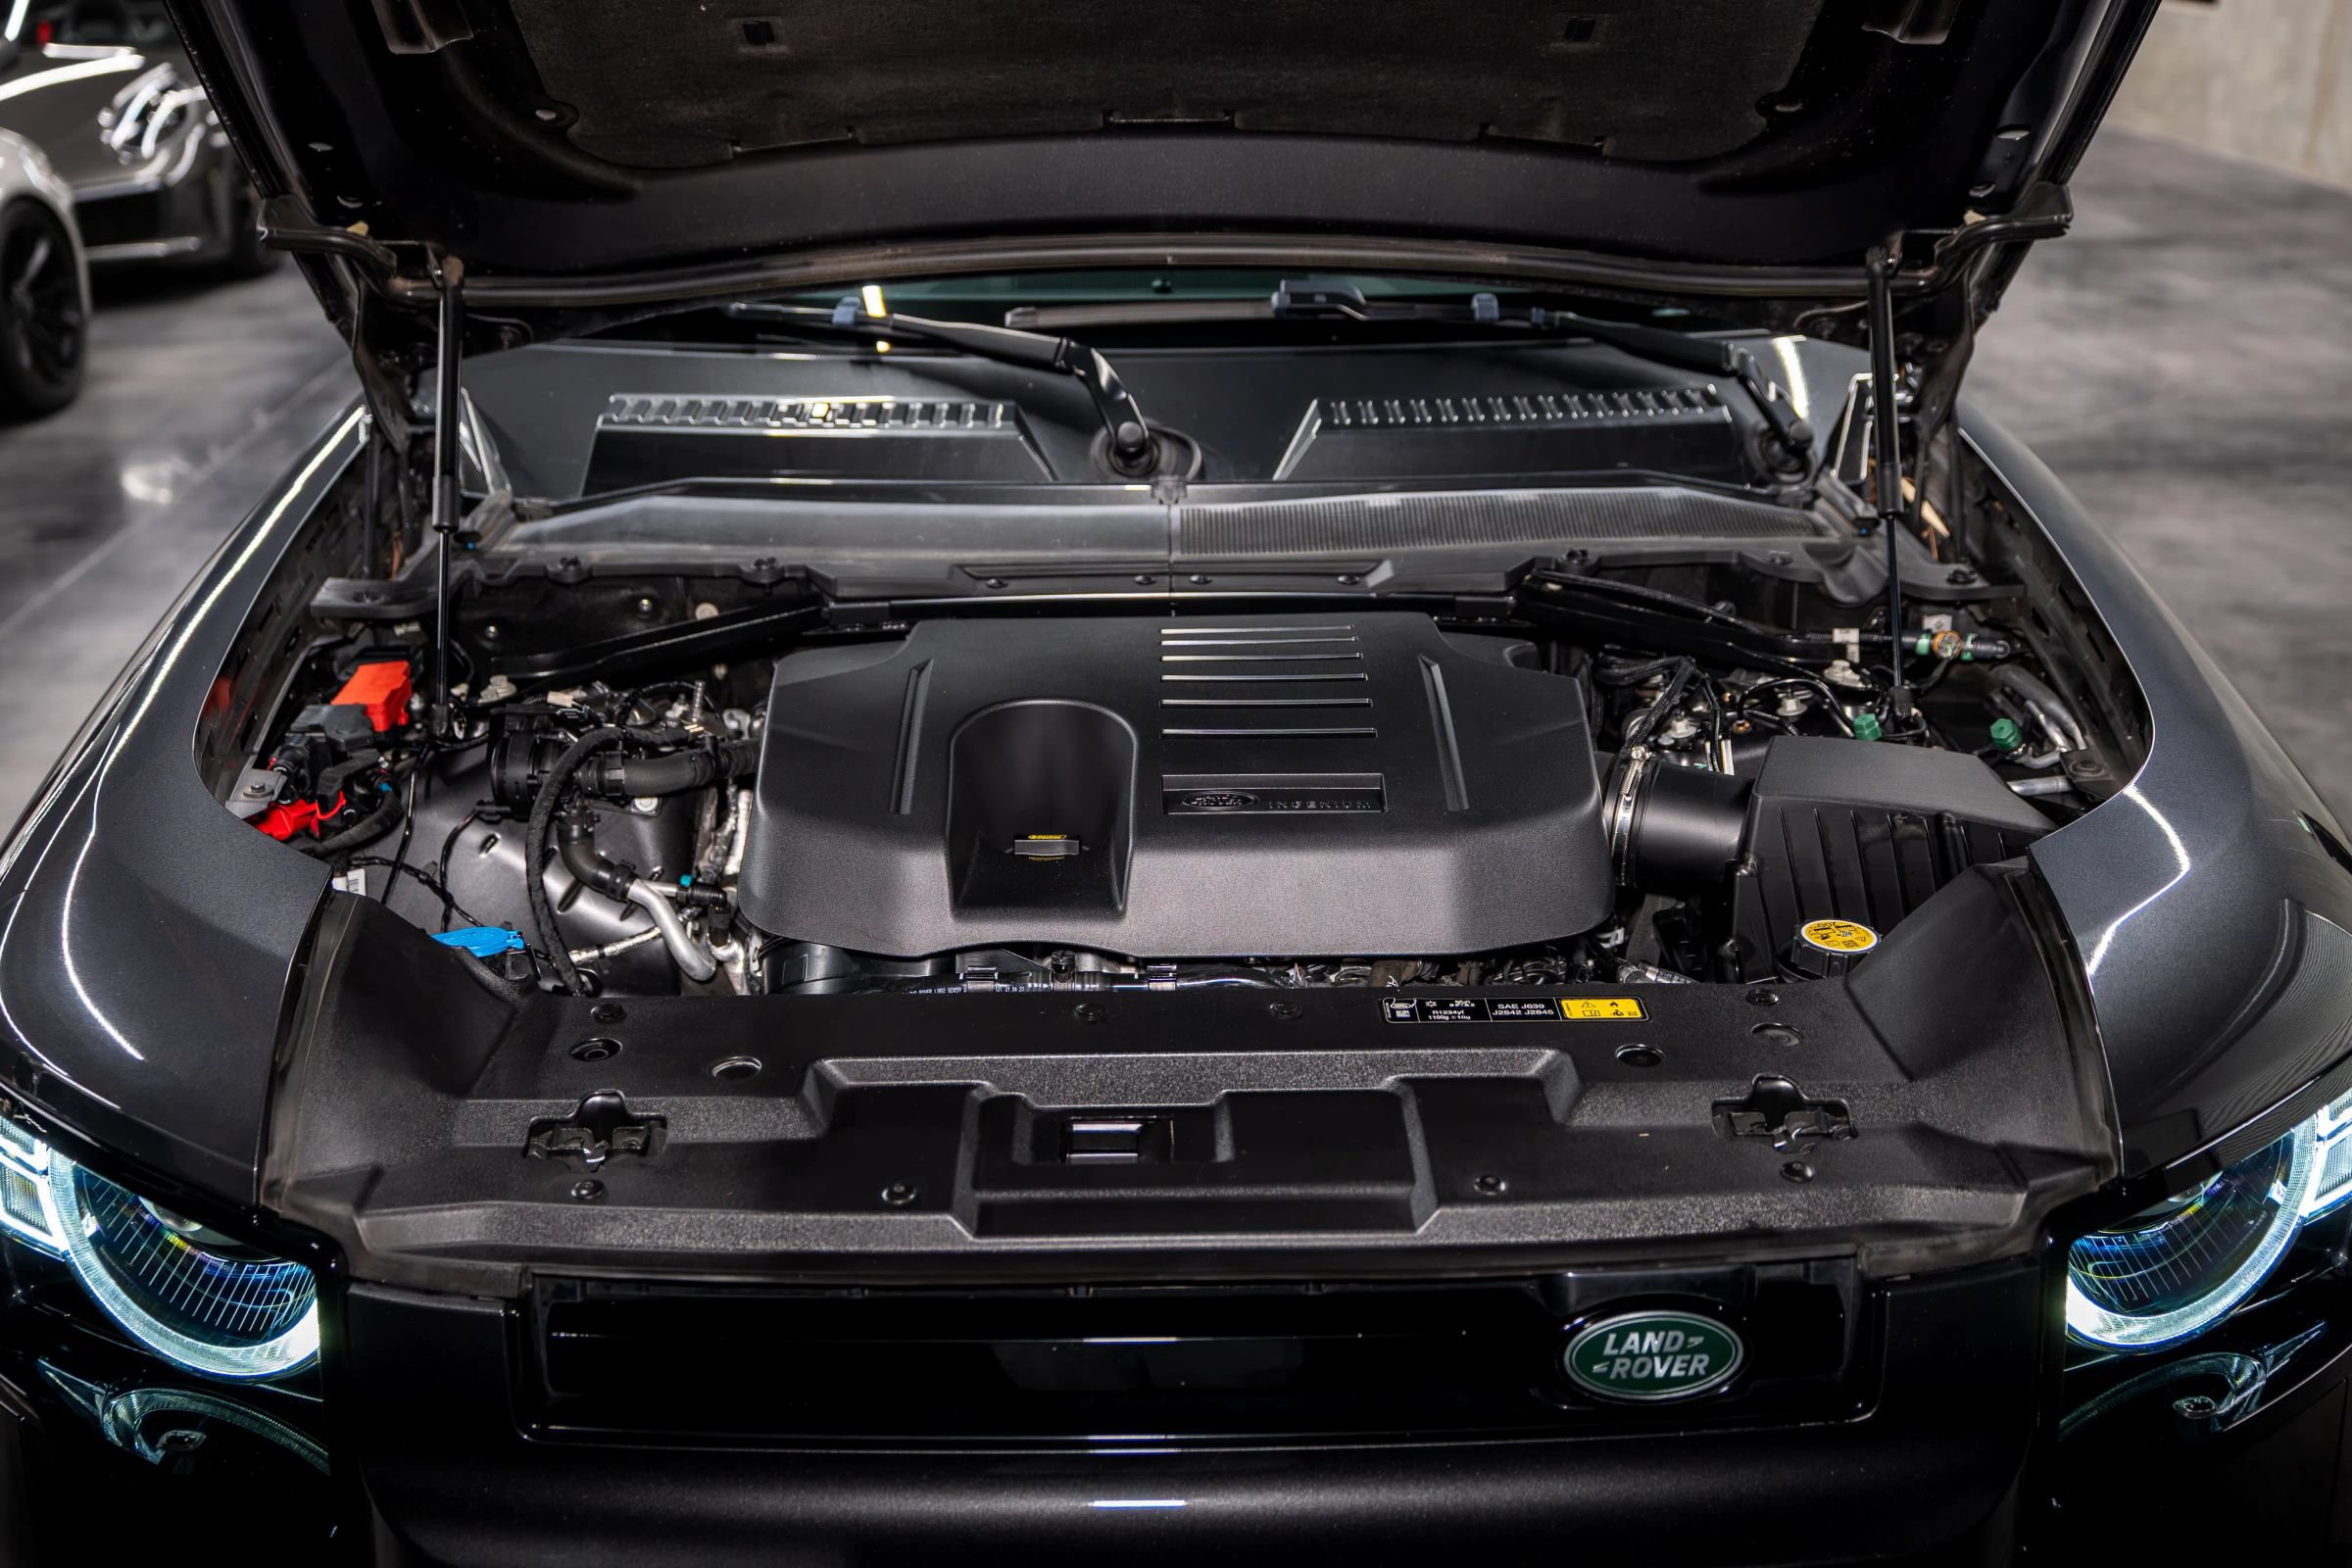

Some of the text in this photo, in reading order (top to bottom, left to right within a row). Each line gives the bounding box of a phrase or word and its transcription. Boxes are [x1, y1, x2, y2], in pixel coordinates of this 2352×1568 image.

[1268, 800, 1371, 808] INGENIUM
[1603, 1330, 1685, 1355] LAND
[1609, 1353, 1710, 1380] ROVER
